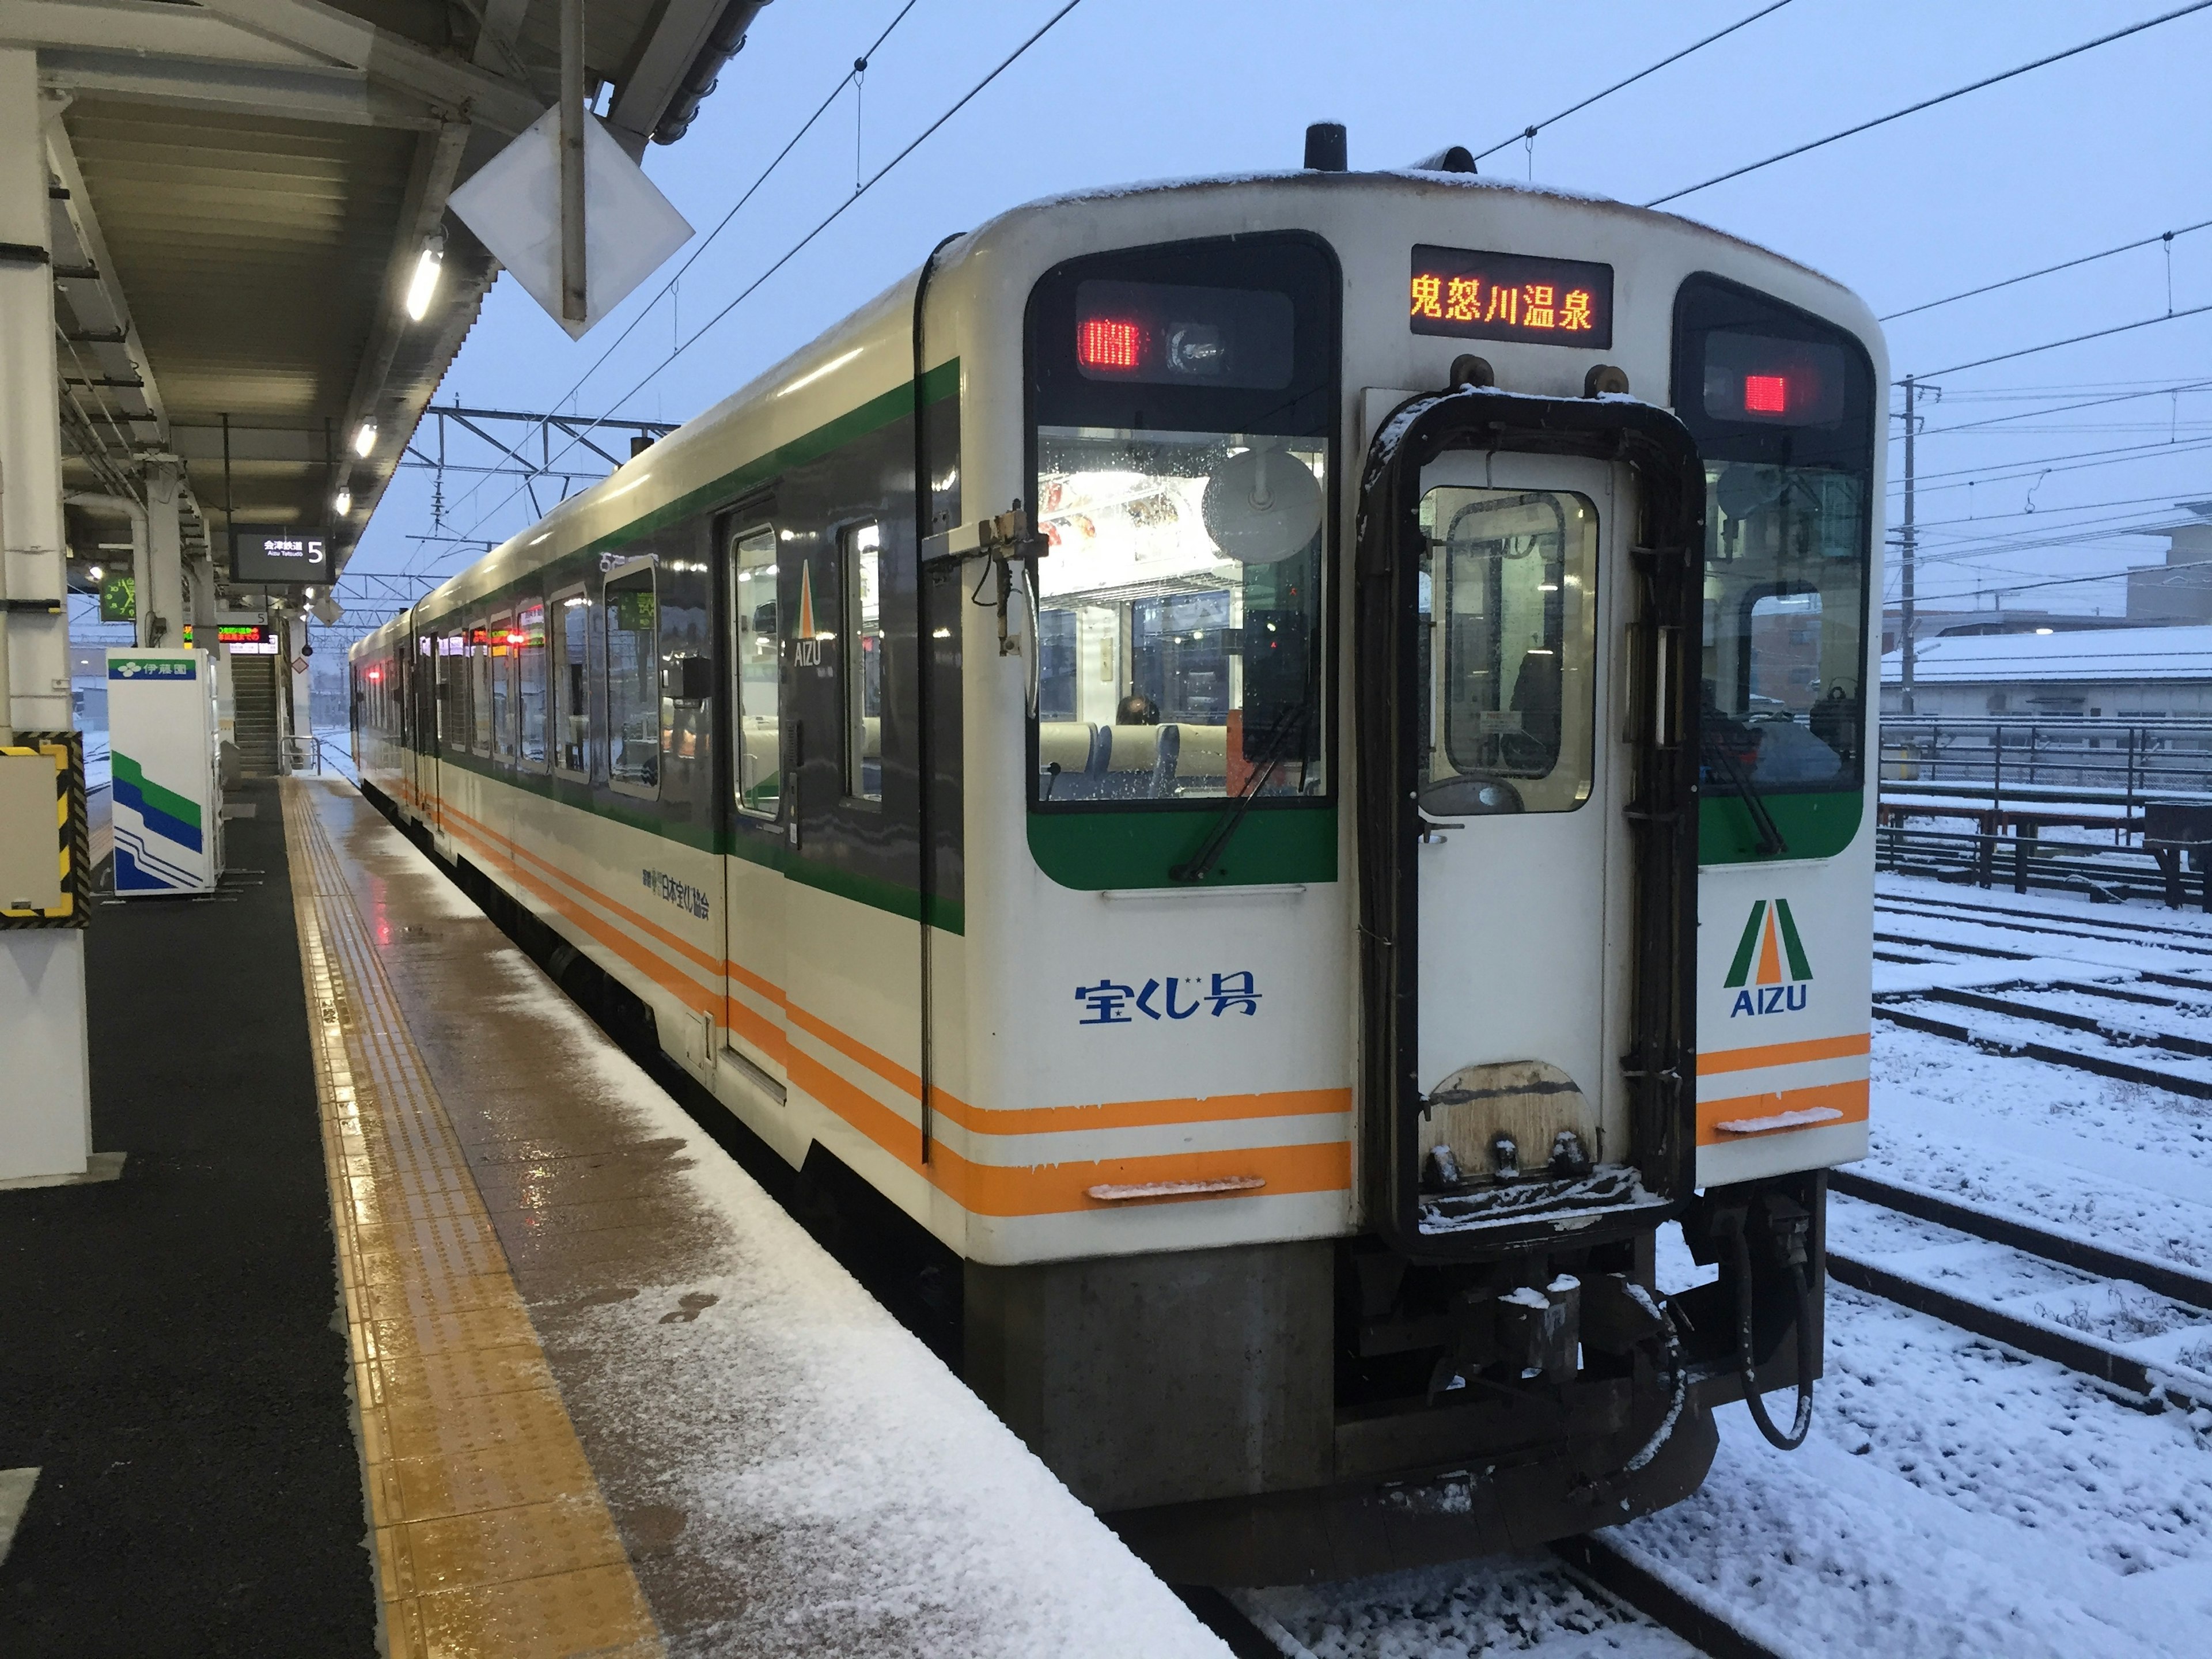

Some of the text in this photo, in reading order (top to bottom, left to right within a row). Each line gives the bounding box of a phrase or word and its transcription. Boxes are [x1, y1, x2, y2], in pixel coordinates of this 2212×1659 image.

[1411, 273, 1592, 331] 鬼怒川温泉
[264, 540, 323, 563] 会津鉄道 5
[257, 613, 265, 623] 5
[794, 640, 821, 667] AIZU
[143, 663, 187, 675] 伊藤園
[1074, 970, 1263, 1025] 宝くじ号
[1730, 984, 1807, 1018] AIZU
